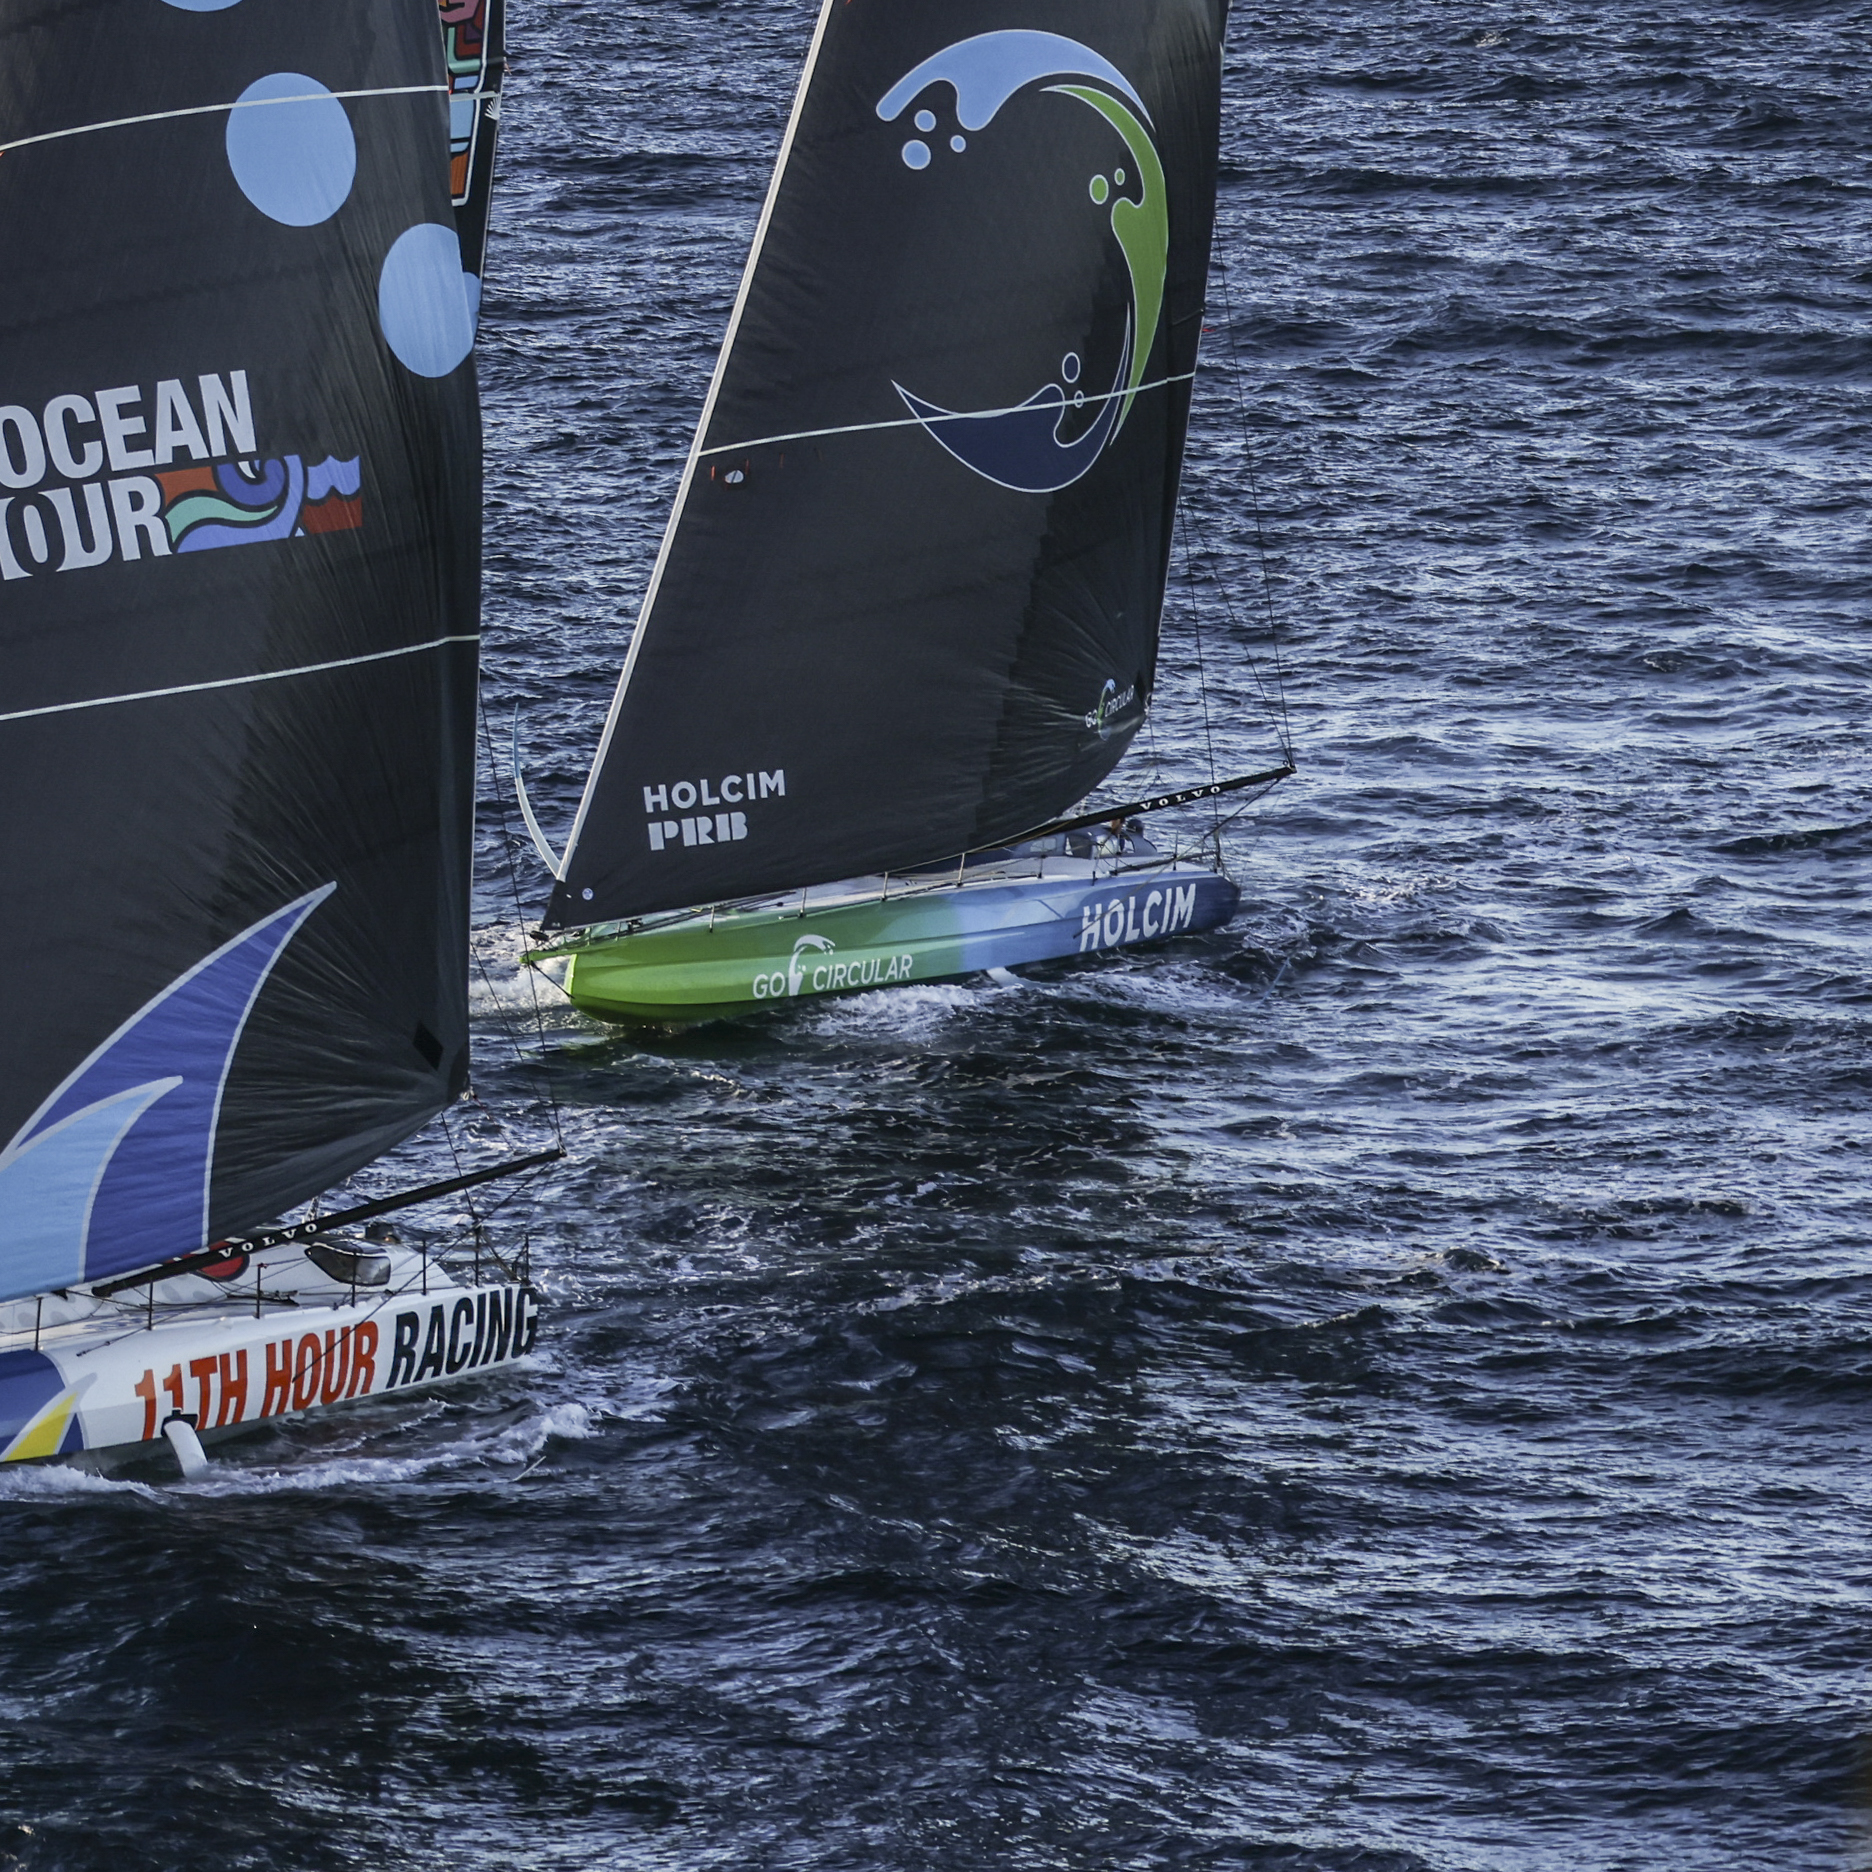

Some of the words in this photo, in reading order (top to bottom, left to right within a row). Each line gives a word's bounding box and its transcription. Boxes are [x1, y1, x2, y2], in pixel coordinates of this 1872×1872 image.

[643, 770, 786, 813] HOLCIM
[1140, 784, 1221, 811] VOLVO
[648, 811, 749, 851] PRB
[1079, 883, 1196, 952] HOLCIM
[753, 971, 786, 1000] GO
[812, 954, 913, 991] CIRCULAR
[218, 1223, 317, 1258] VOLVO
[135, 1349, 248, 1441] 11TH
[262, 1321, 379, 1420] HOUR
[386, 1286, 539, 1389] RACING
